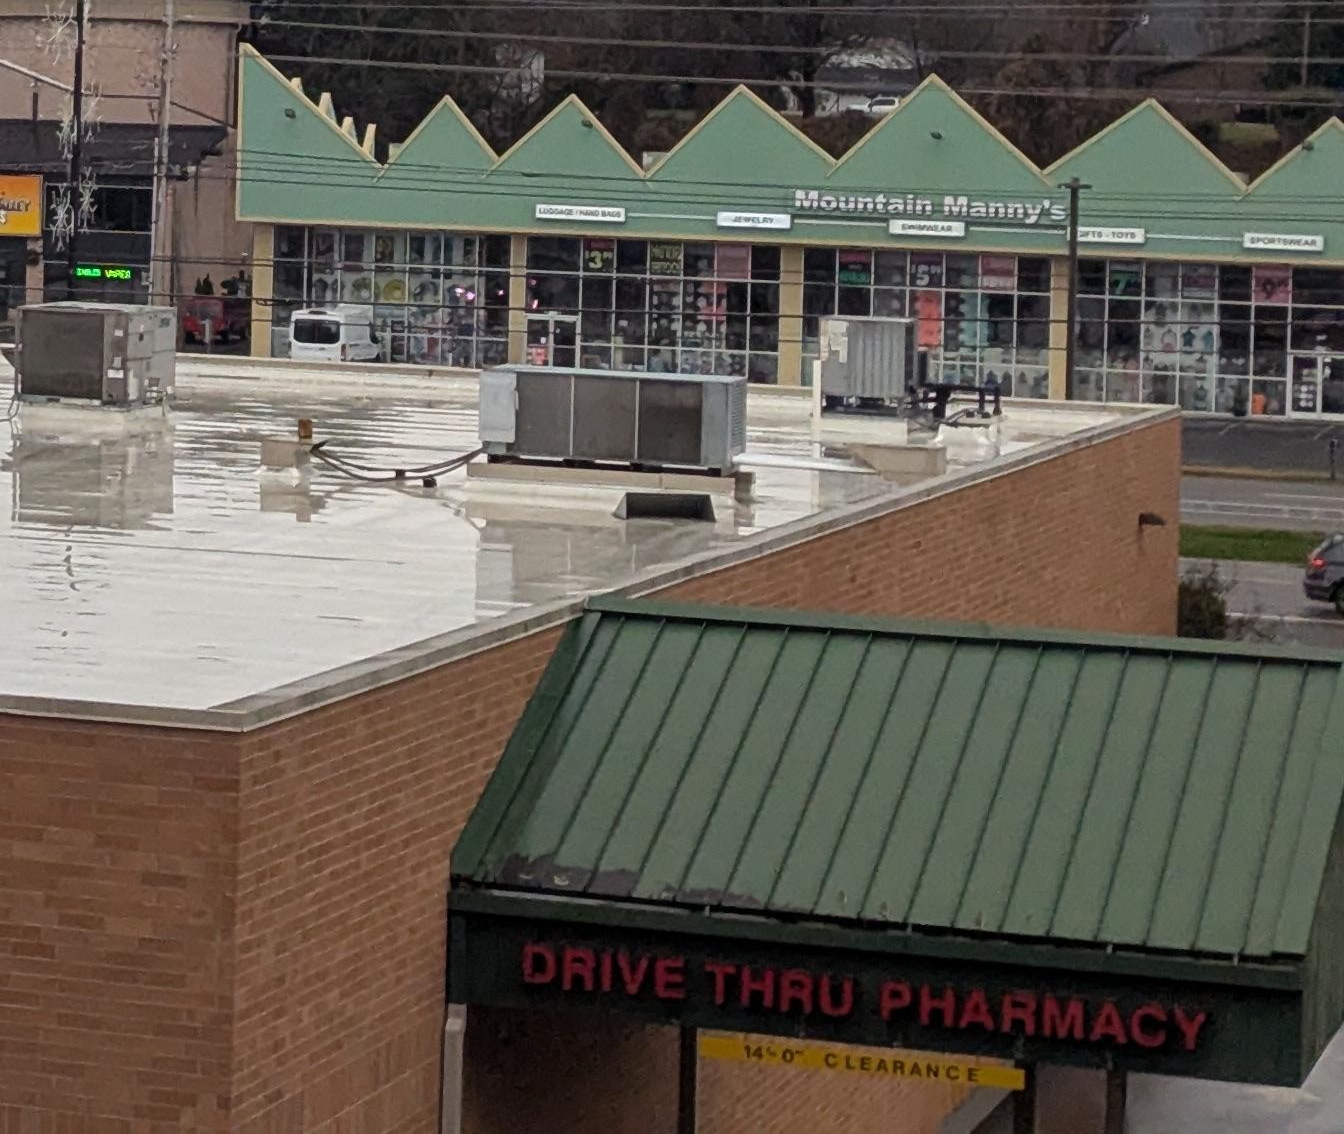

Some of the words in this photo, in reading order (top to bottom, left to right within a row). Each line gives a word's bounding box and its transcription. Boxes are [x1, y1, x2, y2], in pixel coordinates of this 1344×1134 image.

[538, 207, 574, 216] LUGGAGE
[600, 210, 622, 218] BAGS
[794, 189, 932, 215] Mountain
[943, 195, 1067, 224] Manny's
[732, 215, 774, 224] JEWELRY
[1249, 236, 1318, 247] SPORTSWEAR
[521, 942, 687, 1000] DRIVE
[705, 961, 854, 1016] THRU
[878, 978, 1207, 1051] PHARMACY
[824, 1052, 980, 1082] CLEARANCE
